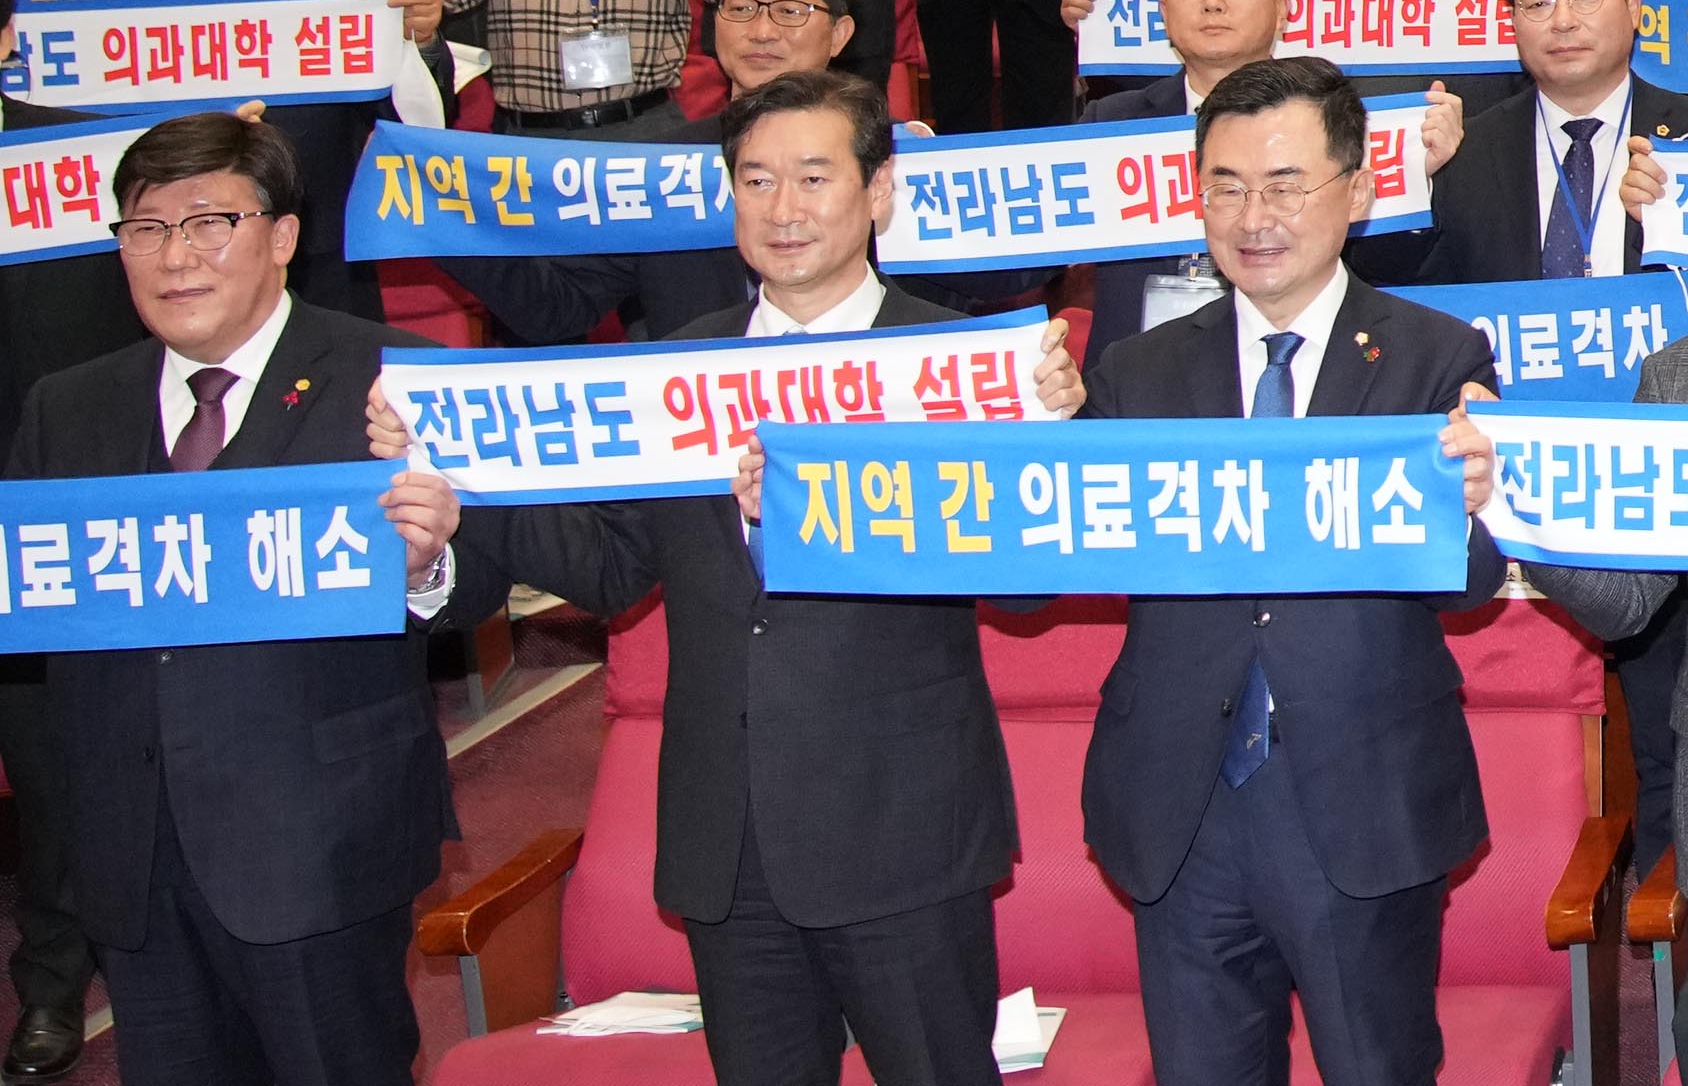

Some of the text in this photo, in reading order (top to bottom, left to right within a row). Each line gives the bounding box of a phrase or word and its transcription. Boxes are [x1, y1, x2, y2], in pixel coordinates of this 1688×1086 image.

[104, 14, 374, 84] 의과대학 설립
[376, 155, 534, 226] 지역 간
[911, 160, 1091, 240] 전라남도
[1470, 302, 1669, 387] 의료격차
[411, 350, 1022, 470] 전라남도 의과대학 설립
[798, 457, 1426, 554] 지역 간 의료격차 해소
[248, 506, 371, 599] 해소
